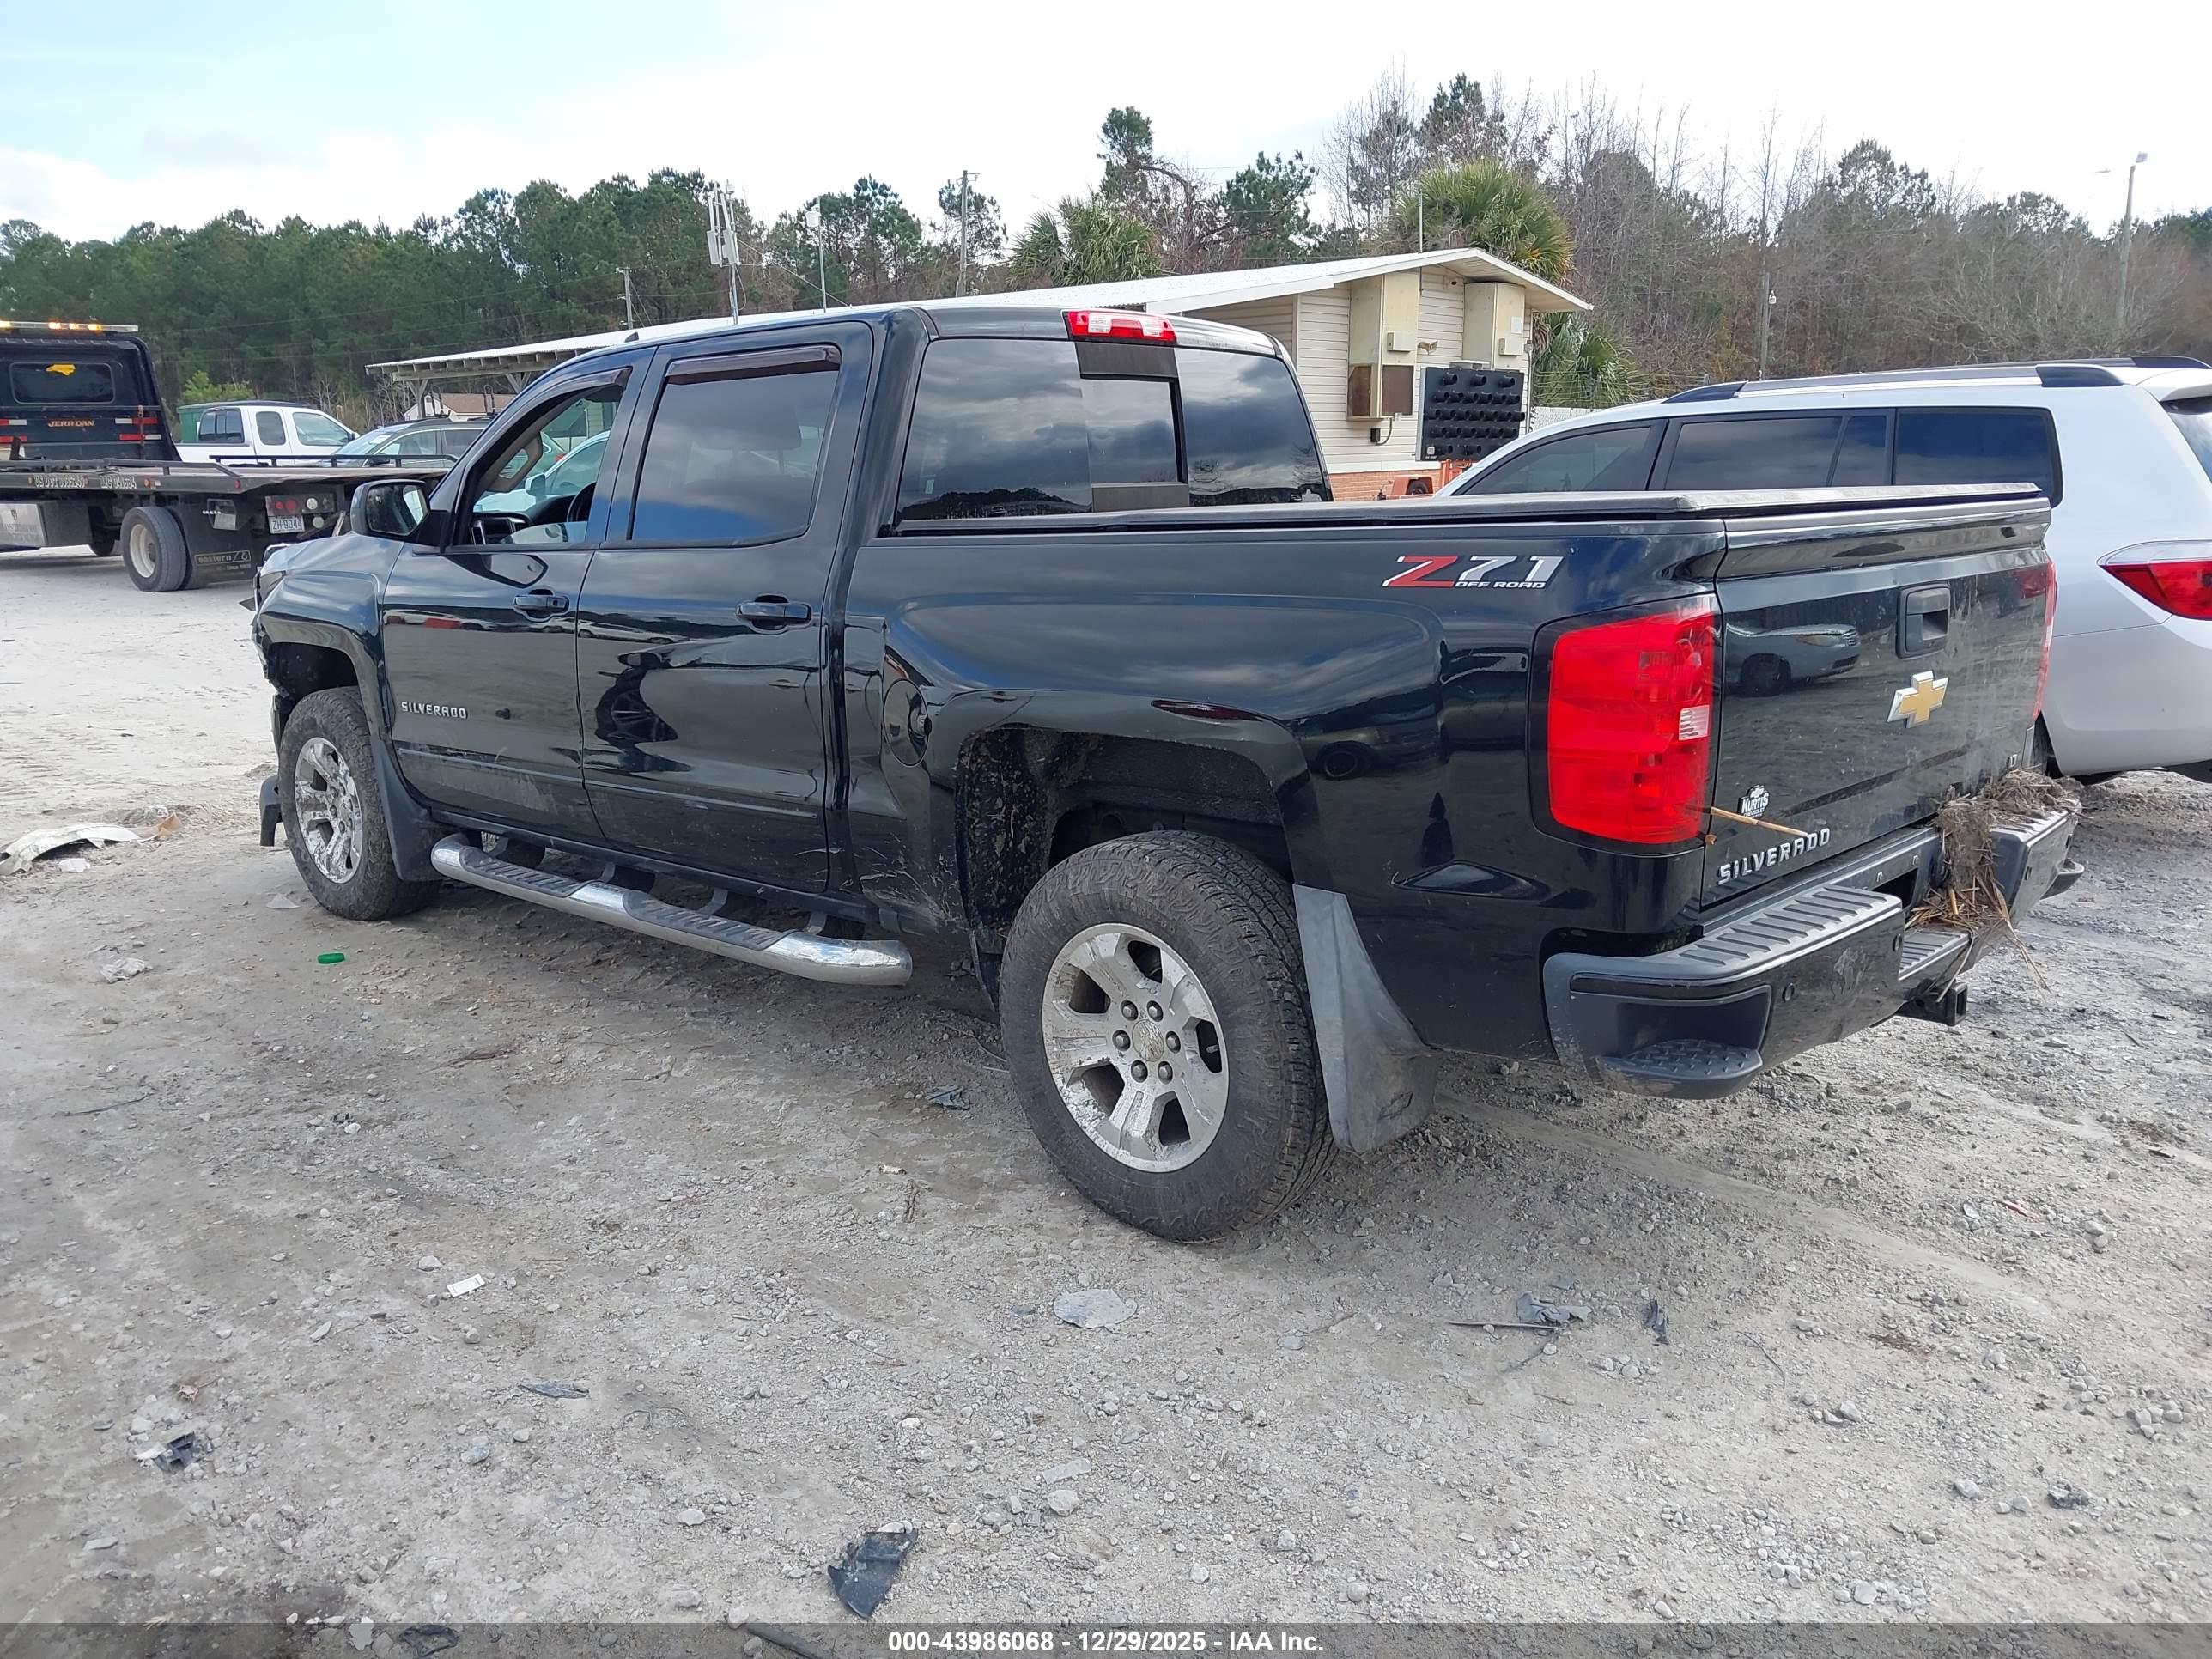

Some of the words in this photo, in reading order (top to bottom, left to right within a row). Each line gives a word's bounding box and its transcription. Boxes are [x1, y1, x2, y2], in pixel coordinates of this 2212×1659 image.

[1382, 556, 1564, 588] Z71
[401, 702, 467, 719] SILVERADO
[1741, 792, 1770, 814] KURTIS
[1718, 828, 1831, 885] SILVERADO
